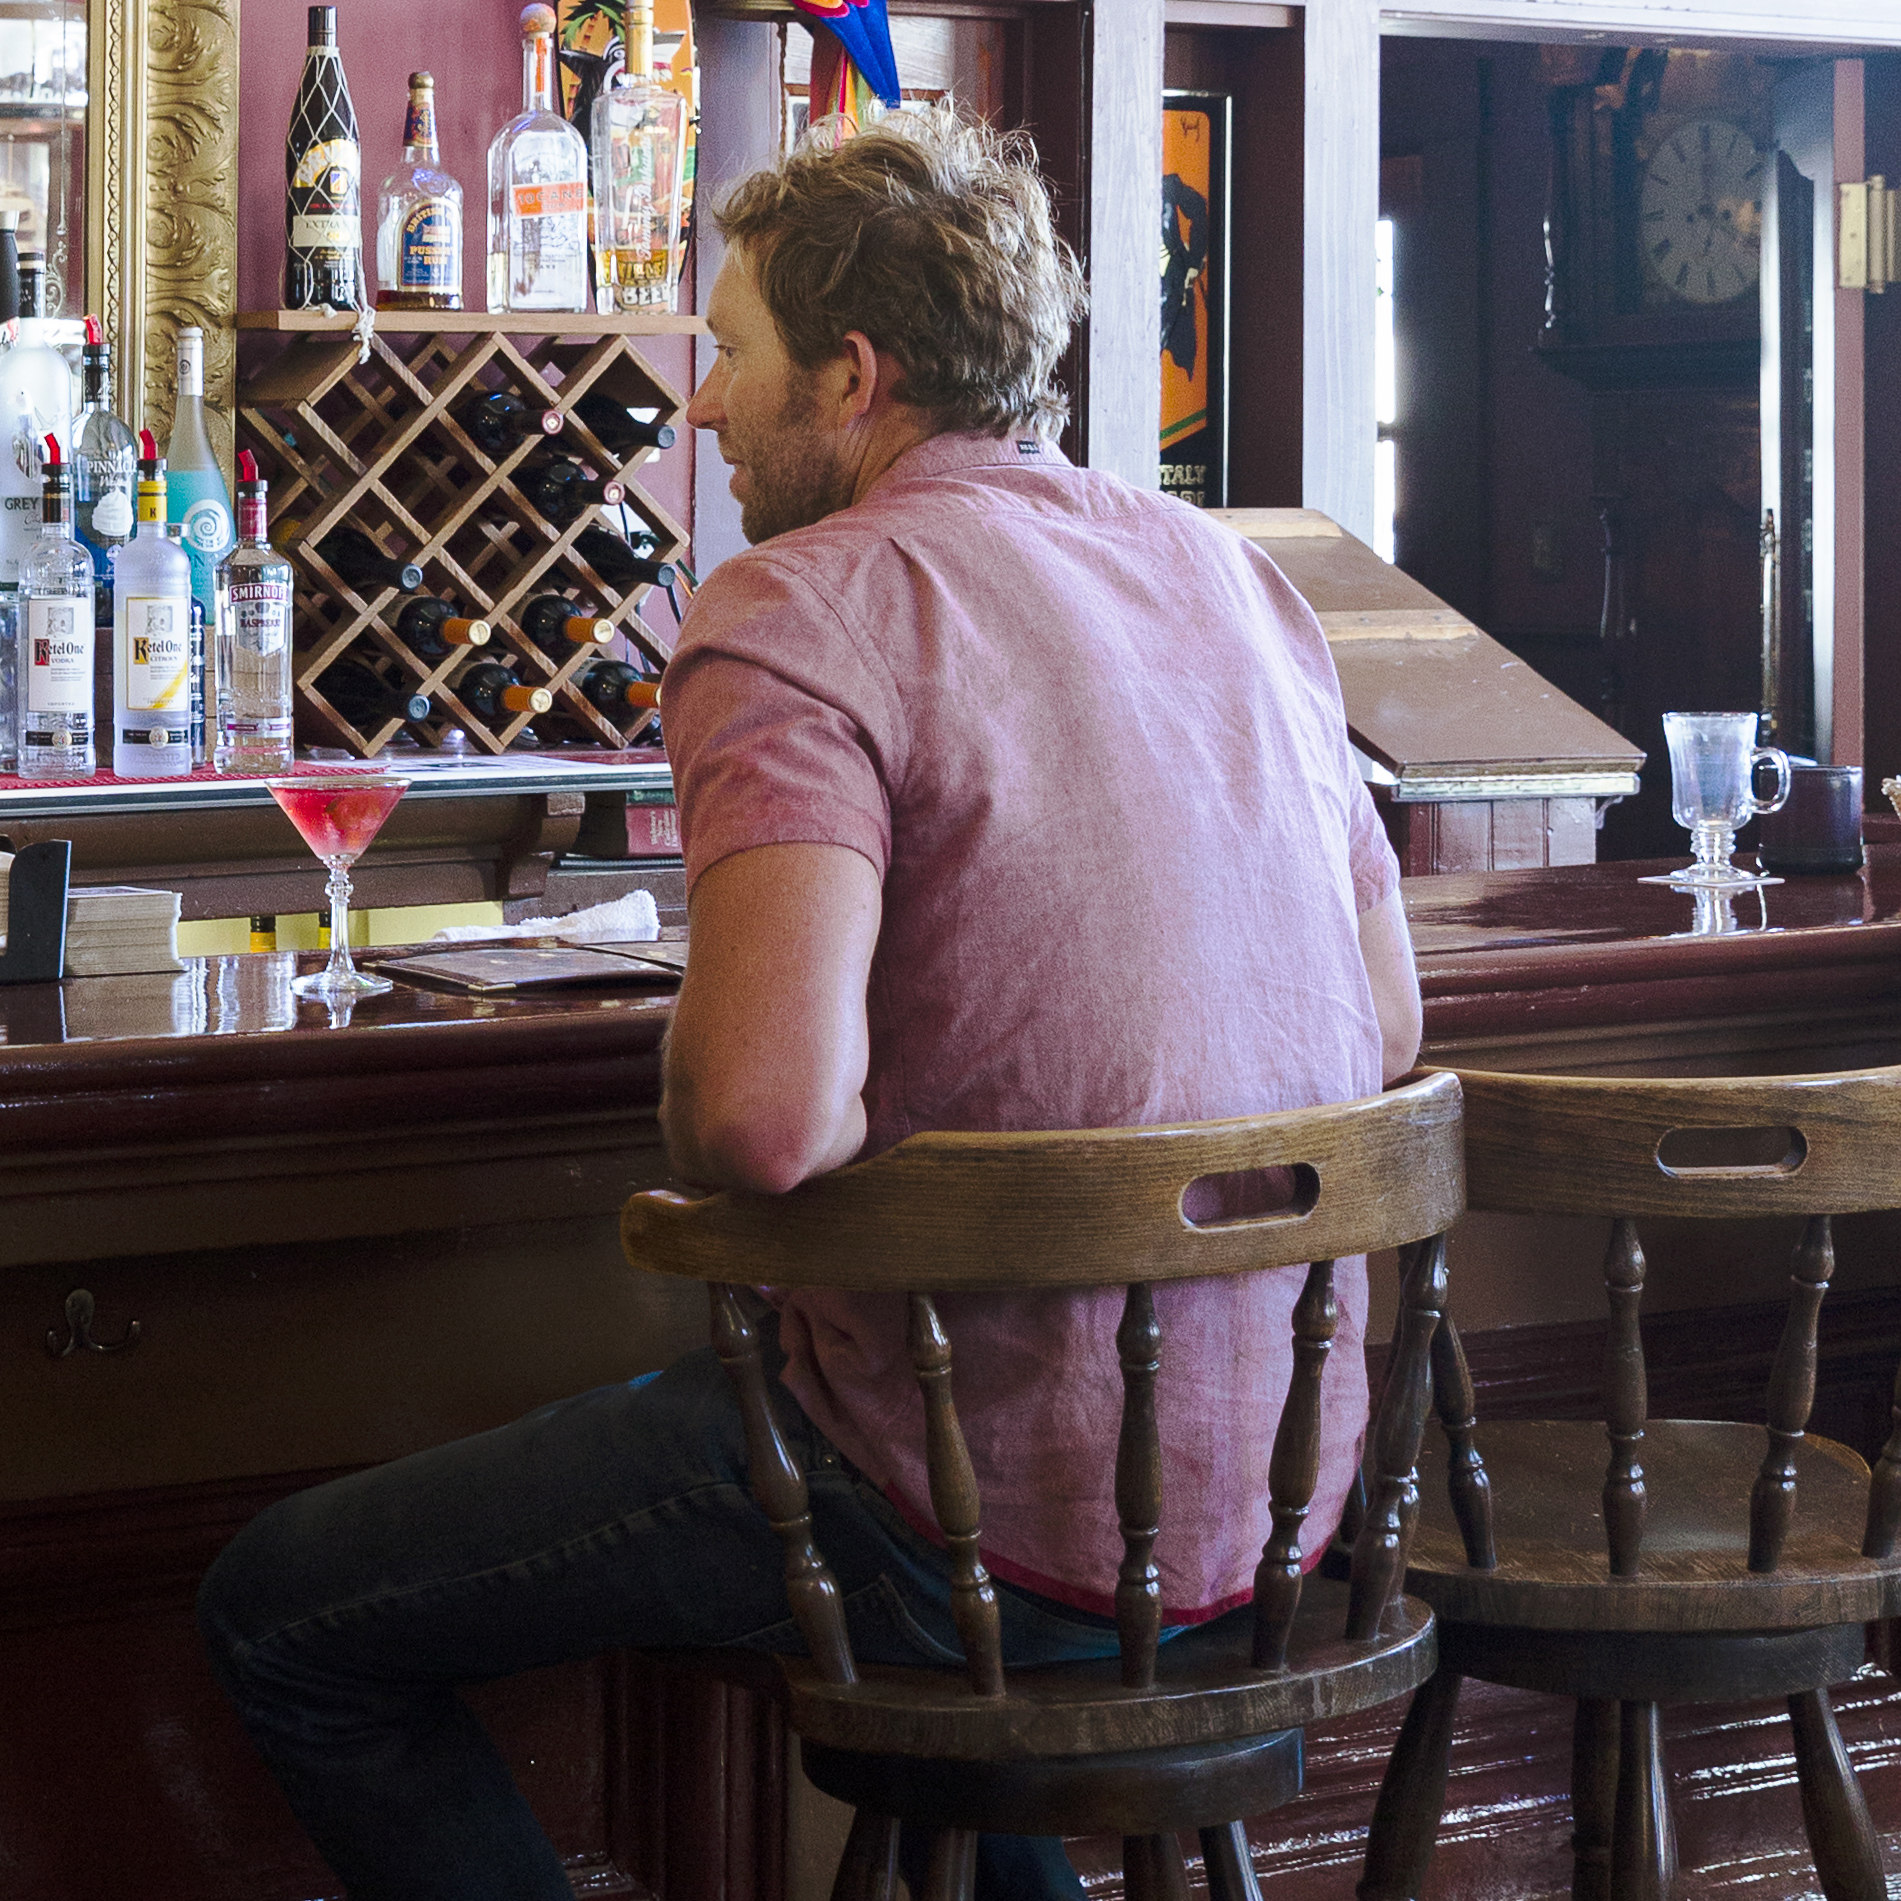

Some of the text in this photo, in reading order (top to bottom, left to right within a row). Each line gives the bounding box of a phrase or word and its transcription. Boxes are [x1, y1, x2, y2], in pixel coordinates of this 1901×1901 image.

[1158, 464, 1206, 485] TALY
[4, 498, 38, 510] GREY
[35, 639, 85, 665] Ketel One
[134, 637, 182, 664] Ketel One
